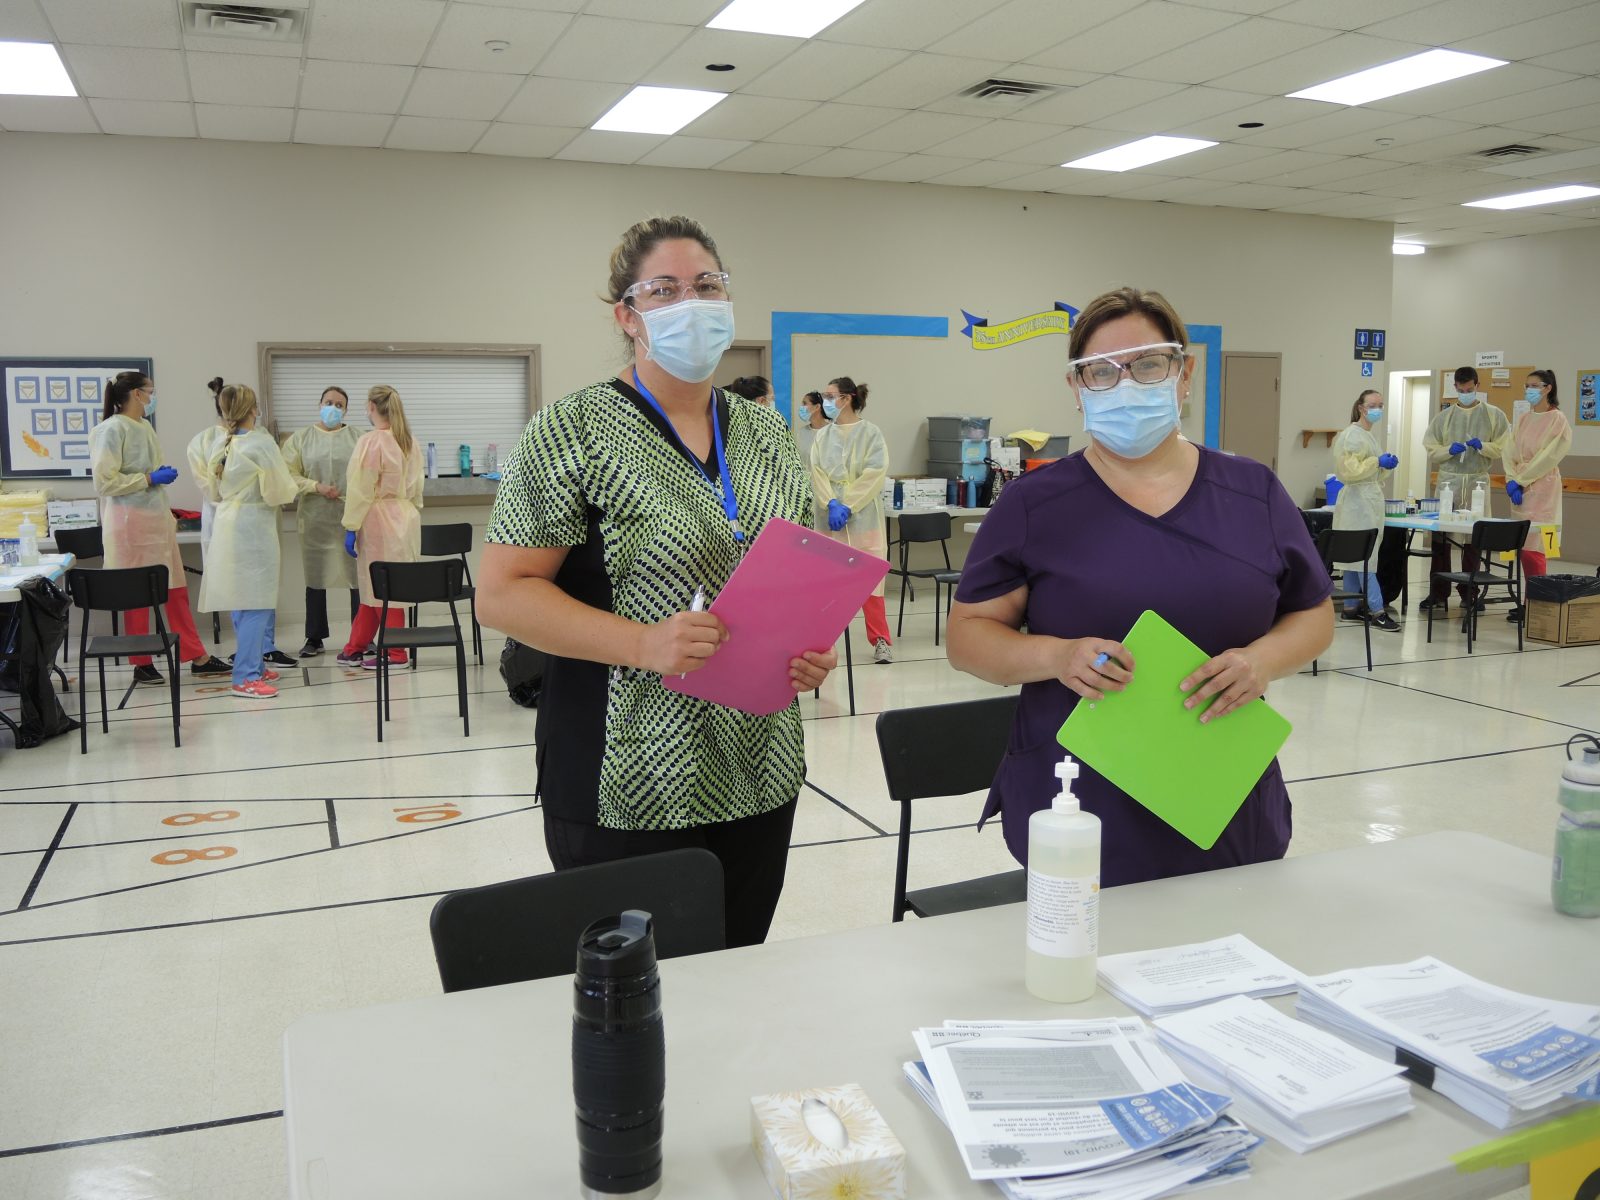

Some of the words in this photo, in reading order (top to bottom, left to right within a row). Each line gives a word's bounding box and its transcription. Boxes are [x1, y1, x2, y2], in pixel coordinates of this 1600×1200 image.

[1545, 532, 1554, 550] 7
[161, 810, 241, 827] 8
[392, 802, 463, 823] 10
[150, 845, 239, 865] 8
